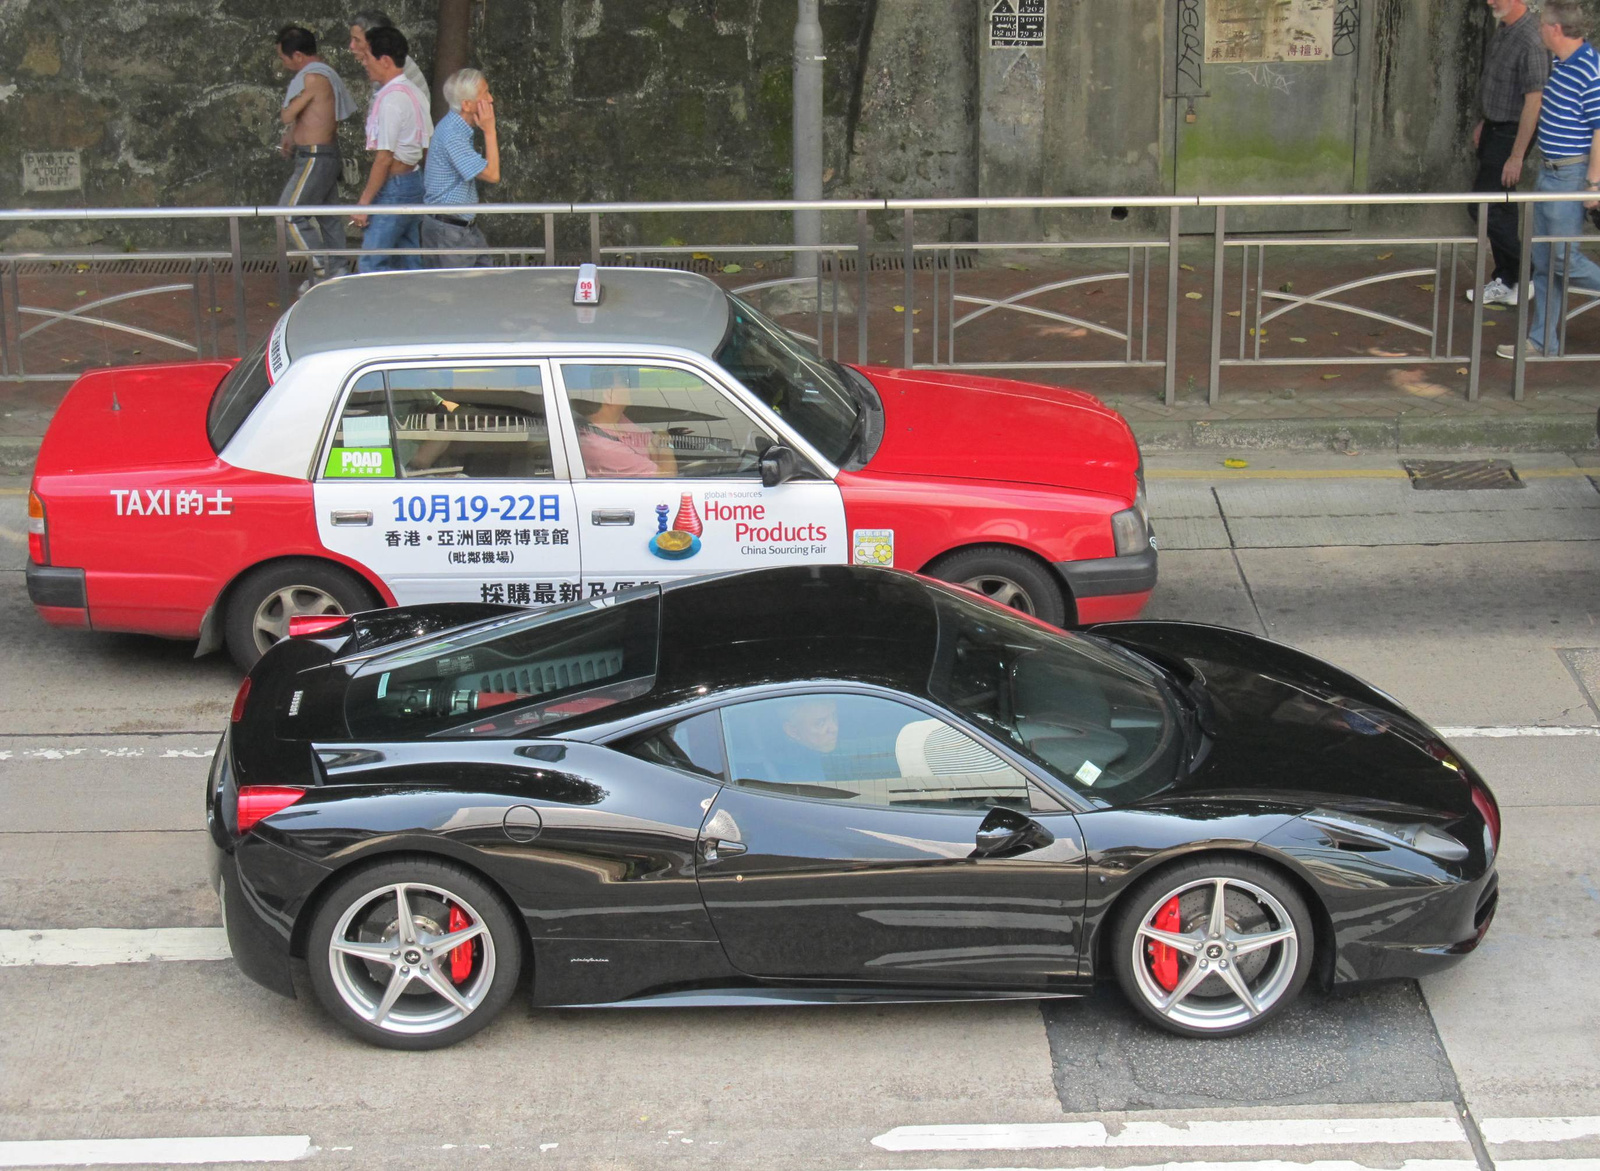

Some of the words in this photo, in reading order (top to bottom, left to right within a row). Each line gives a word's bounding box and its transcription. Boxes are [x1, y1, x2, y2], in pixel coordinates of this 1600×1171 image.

[341, 451, 382, 468] POAD
[110, 489, 171, 516] TAXI
[176, 489, 233, 516] 的士
[704, 490, 727, 500] global
[733, 490, 763, 498] sources
[392, 494, 561, 523] 10月19-22日
[704, 500, 766, 521] Home
[735, 521, 828, 542] Products
[740, 545, 767, 555] China
[768, 545, 809, 556] Sourcing
[810, 544, 827, 554] Fair
